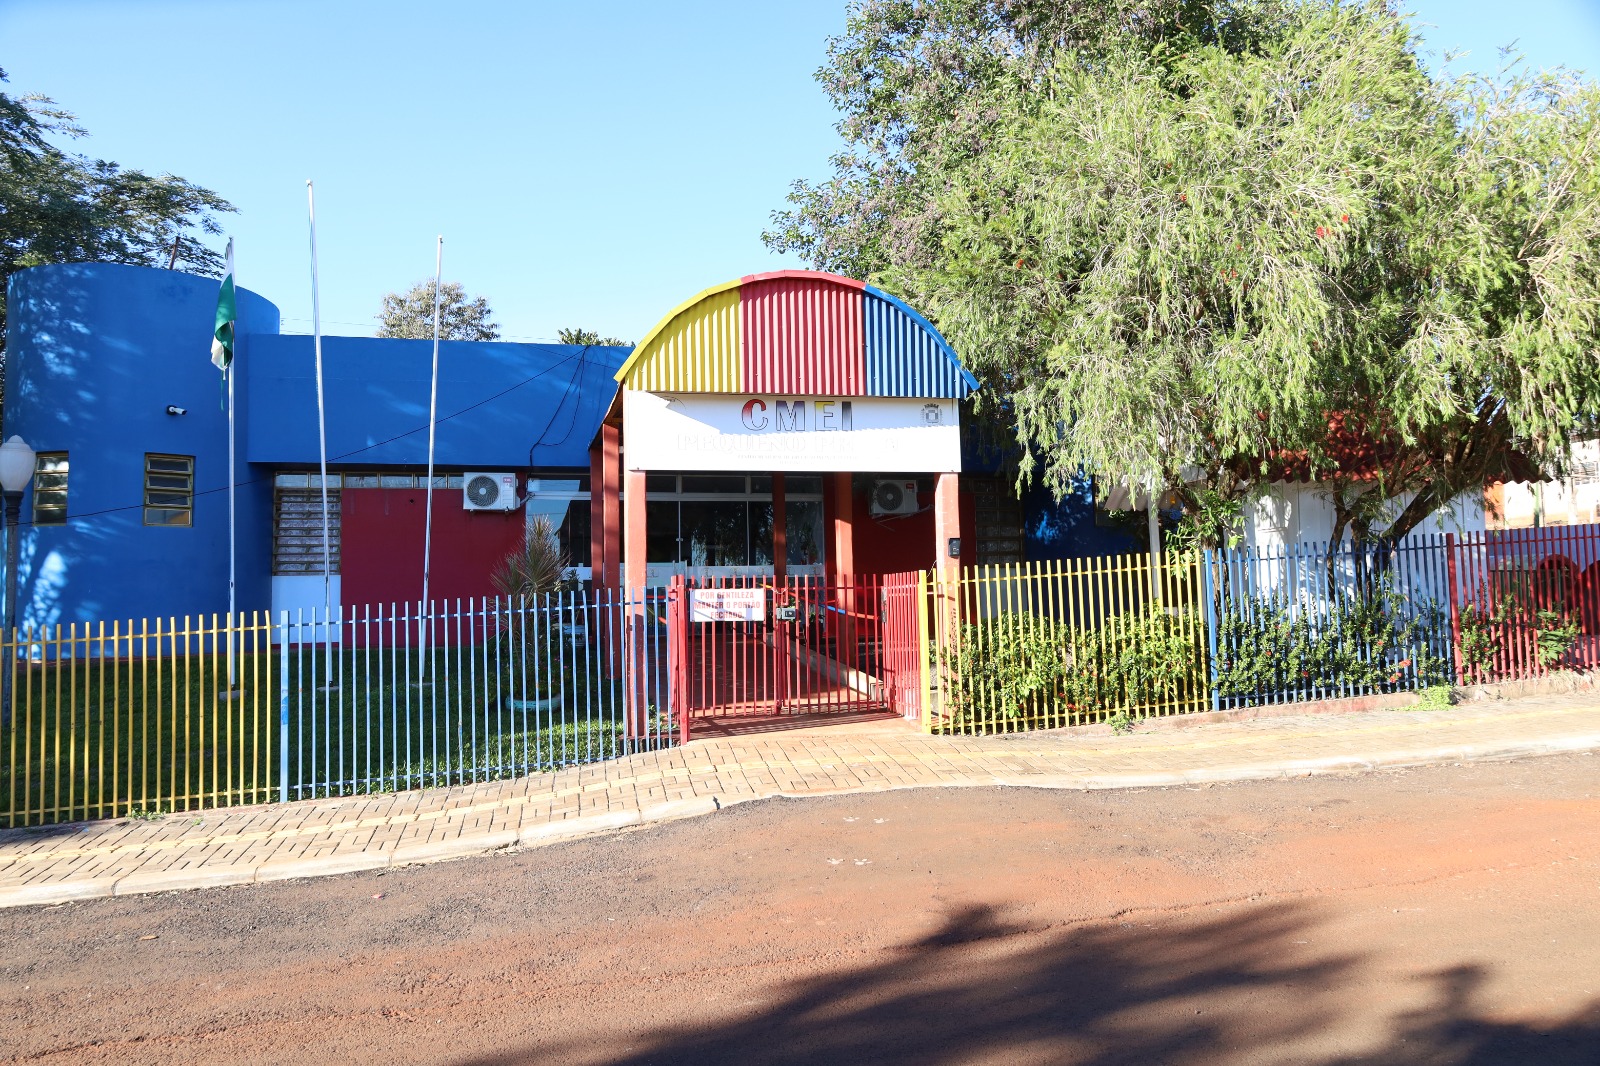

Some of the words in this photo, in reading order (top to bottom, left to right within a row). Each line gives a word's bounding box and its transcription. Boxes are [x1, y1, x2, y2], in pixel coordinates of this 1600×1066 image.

[741, 398, 853, 432] CMEI
[700, 591, 715, 599] POR
[717, 591, 754, 599] GENTILEZA
[693, 601, 724, 609] MANTER
[726, 601, 731, 609] O
[733, 600, 761, 609] PORTÃO
